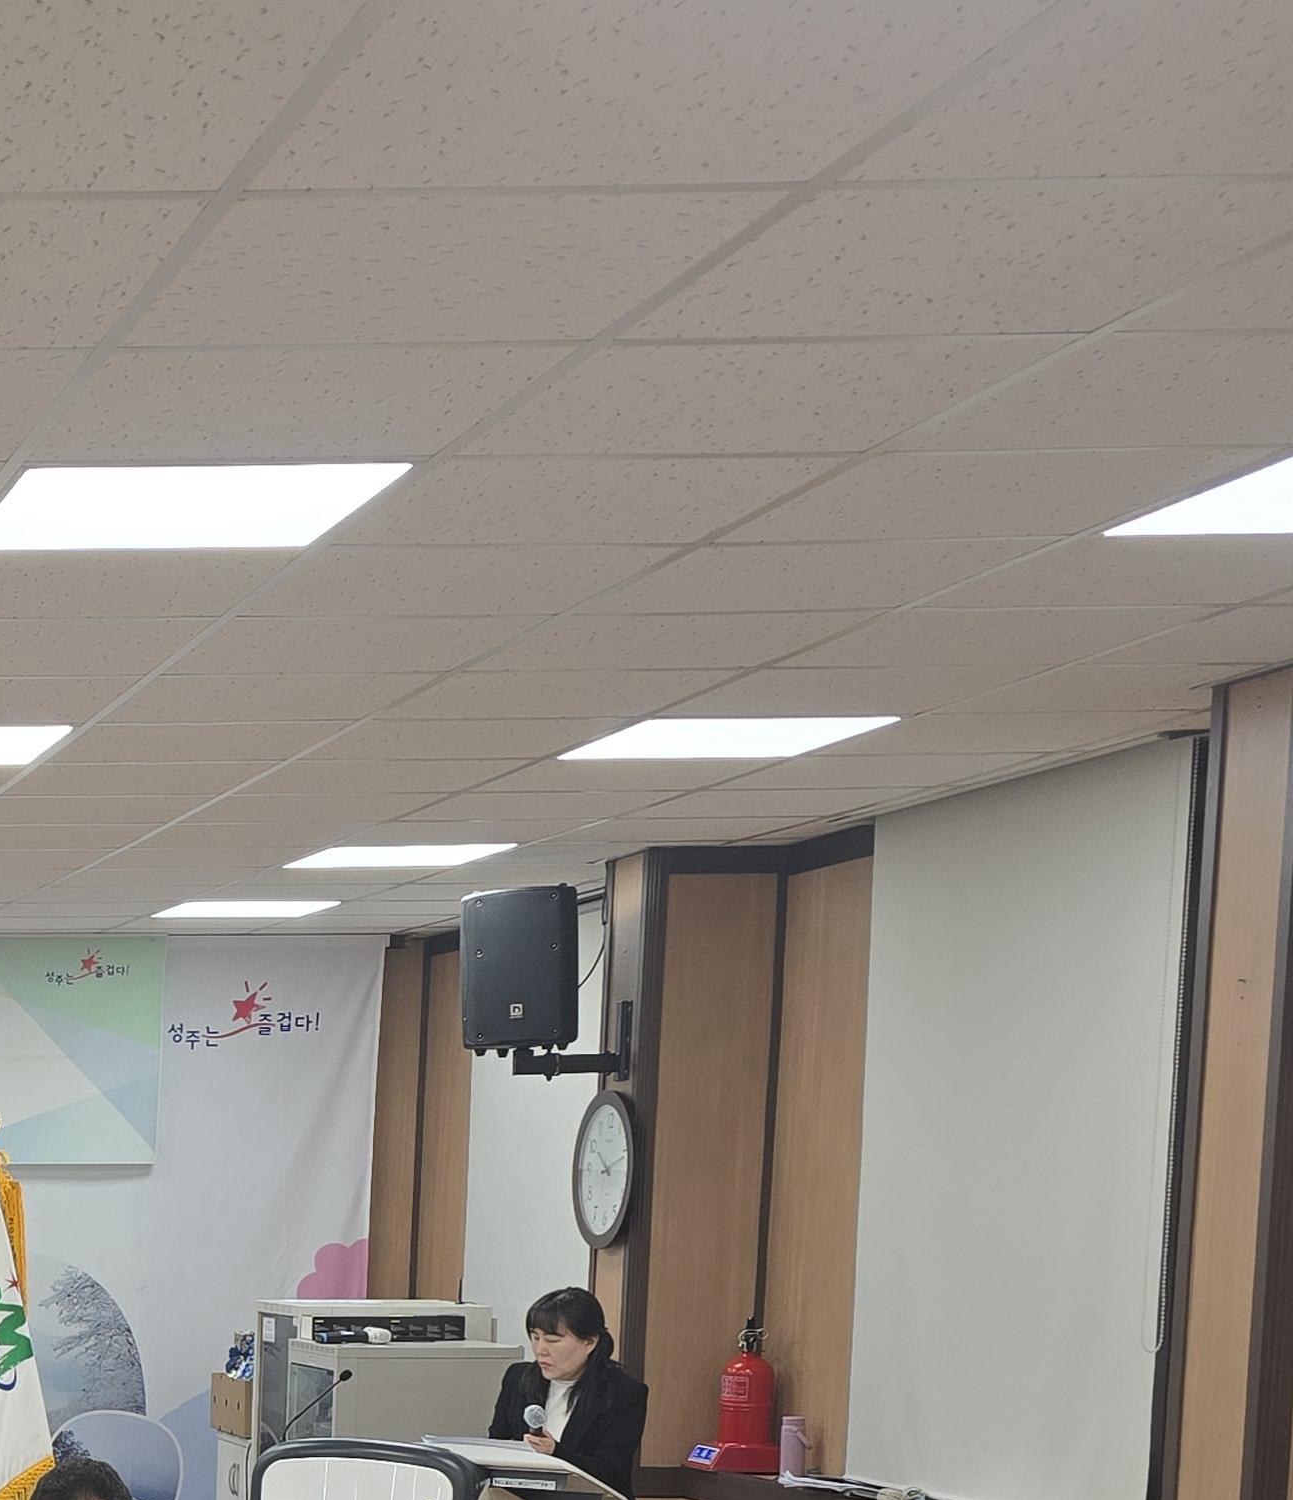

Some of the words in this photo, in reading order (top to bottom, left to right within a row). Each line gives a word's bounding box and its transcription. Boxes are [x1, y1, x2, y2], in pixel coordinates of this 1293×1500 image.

[45, 966, 74, 986] 성주는
[168, 1022, 220, 1050] 성주는
[257, 1012, 321, 1036] 즐겁다!
